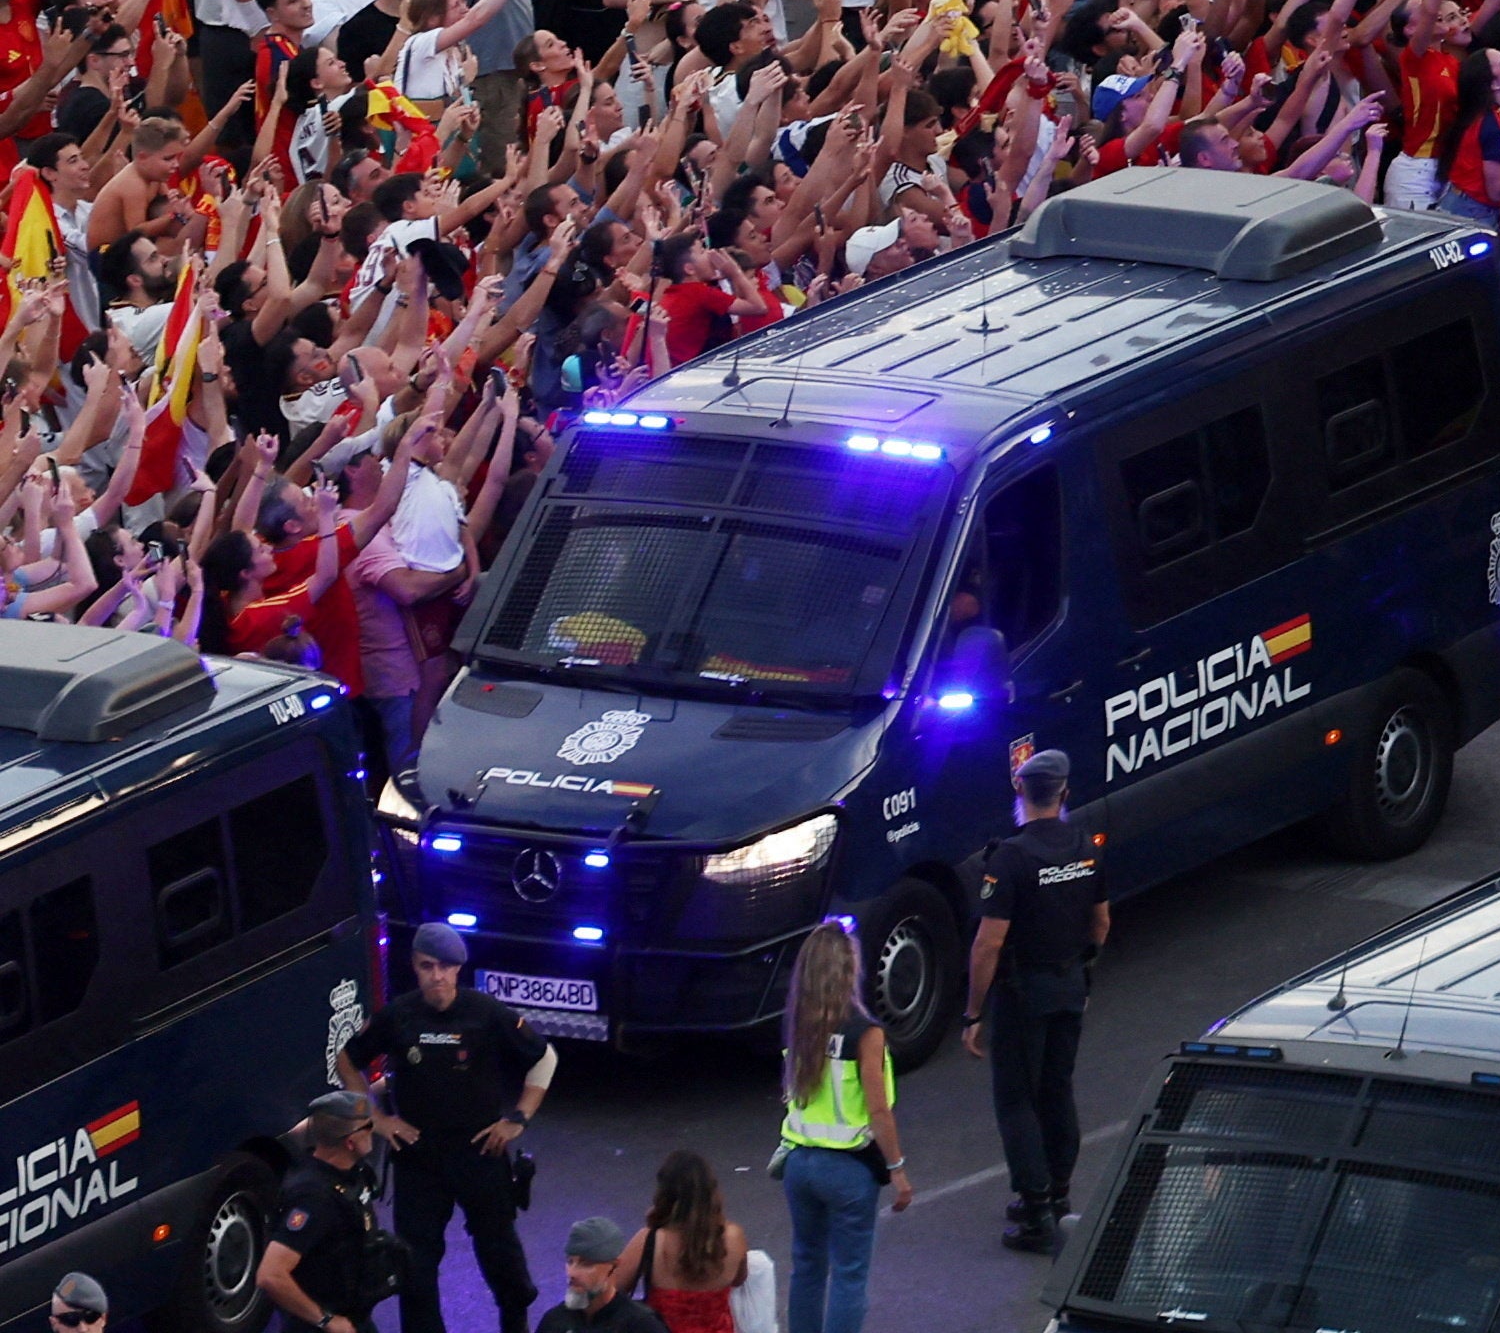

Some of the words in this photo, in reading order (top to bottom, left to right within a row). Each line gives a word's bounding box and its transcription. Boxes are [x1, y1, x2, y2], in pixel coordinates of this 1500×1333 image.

[1430, 241, 1465, 270] 1U-82
[269, 695, 305, 725] 1U-80
[1106, 666, 1312, 782] NACIONAL
[484, 768, 615, 794] POLICIA
[1039, 861, 1085, 878] POLICIA
[1039, 867, 1095, 886] NACIONAL
[485, 973, 595, 1008] CNP3864BD
